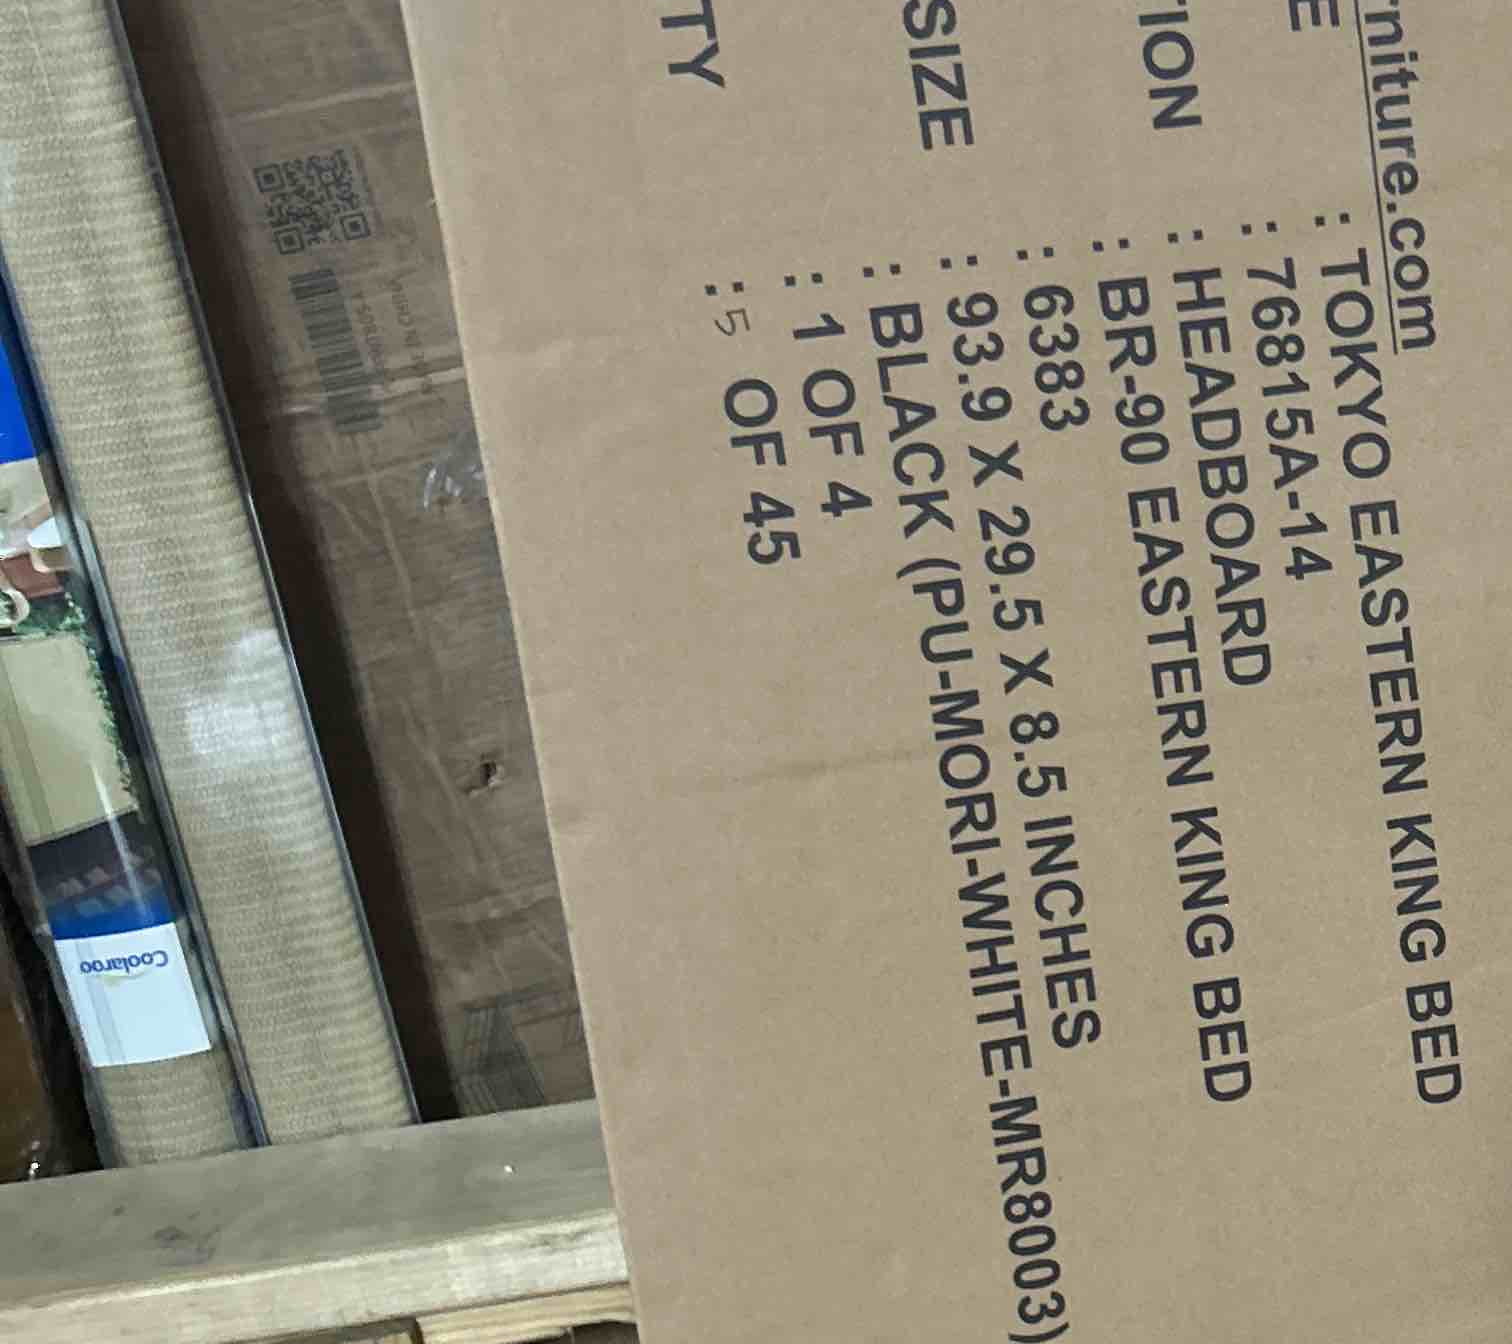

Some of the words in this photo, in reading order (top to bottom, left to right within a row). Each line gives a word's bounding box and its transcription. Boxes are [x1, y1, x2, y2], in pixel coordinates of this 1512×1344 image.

[792, 312, 846, 340] 1
[946, 292, 1013, 422] 93.9
[1023, 284, 1091, 431] 6383
[1097, 275, 1171, 465] BR-90
[1320, 246, 1391, 479] TOKYO
[723, 378, 788, 467] OF
[801, 368, 866, 456] OF
[868, 302, 956, 540] BLACK
[965, 440, 1024, 488] X
[1172, 267, 1272, 686] HEADBOARD
[1246, 256, 1334, 581] 76815A-14
[743, 491, 802, 565] 45
[820, 481, 873, 520] 4
[976, 504, 1045, 632] 29.5
[998, 647, 1054, 696] X
[1127, 486, 1214, 787] EASTERN
[1349, 499, 1429, 795] EASTERN
[1009, 711, 1067, 797] 8.5
[1024, 814, 1102, 1049] INCHES
[1170, 806, 1235, 959] KING
[1385, 813, 1447, 963] KING
[79, 950, 169, 974] Coolaroo
[896, 557, 1070, 1344] (PU-MORI-WHITE-MR8003)
[1192, 976, 1252, 1102] BED
[1405, 979, 1462, 1104] BED
